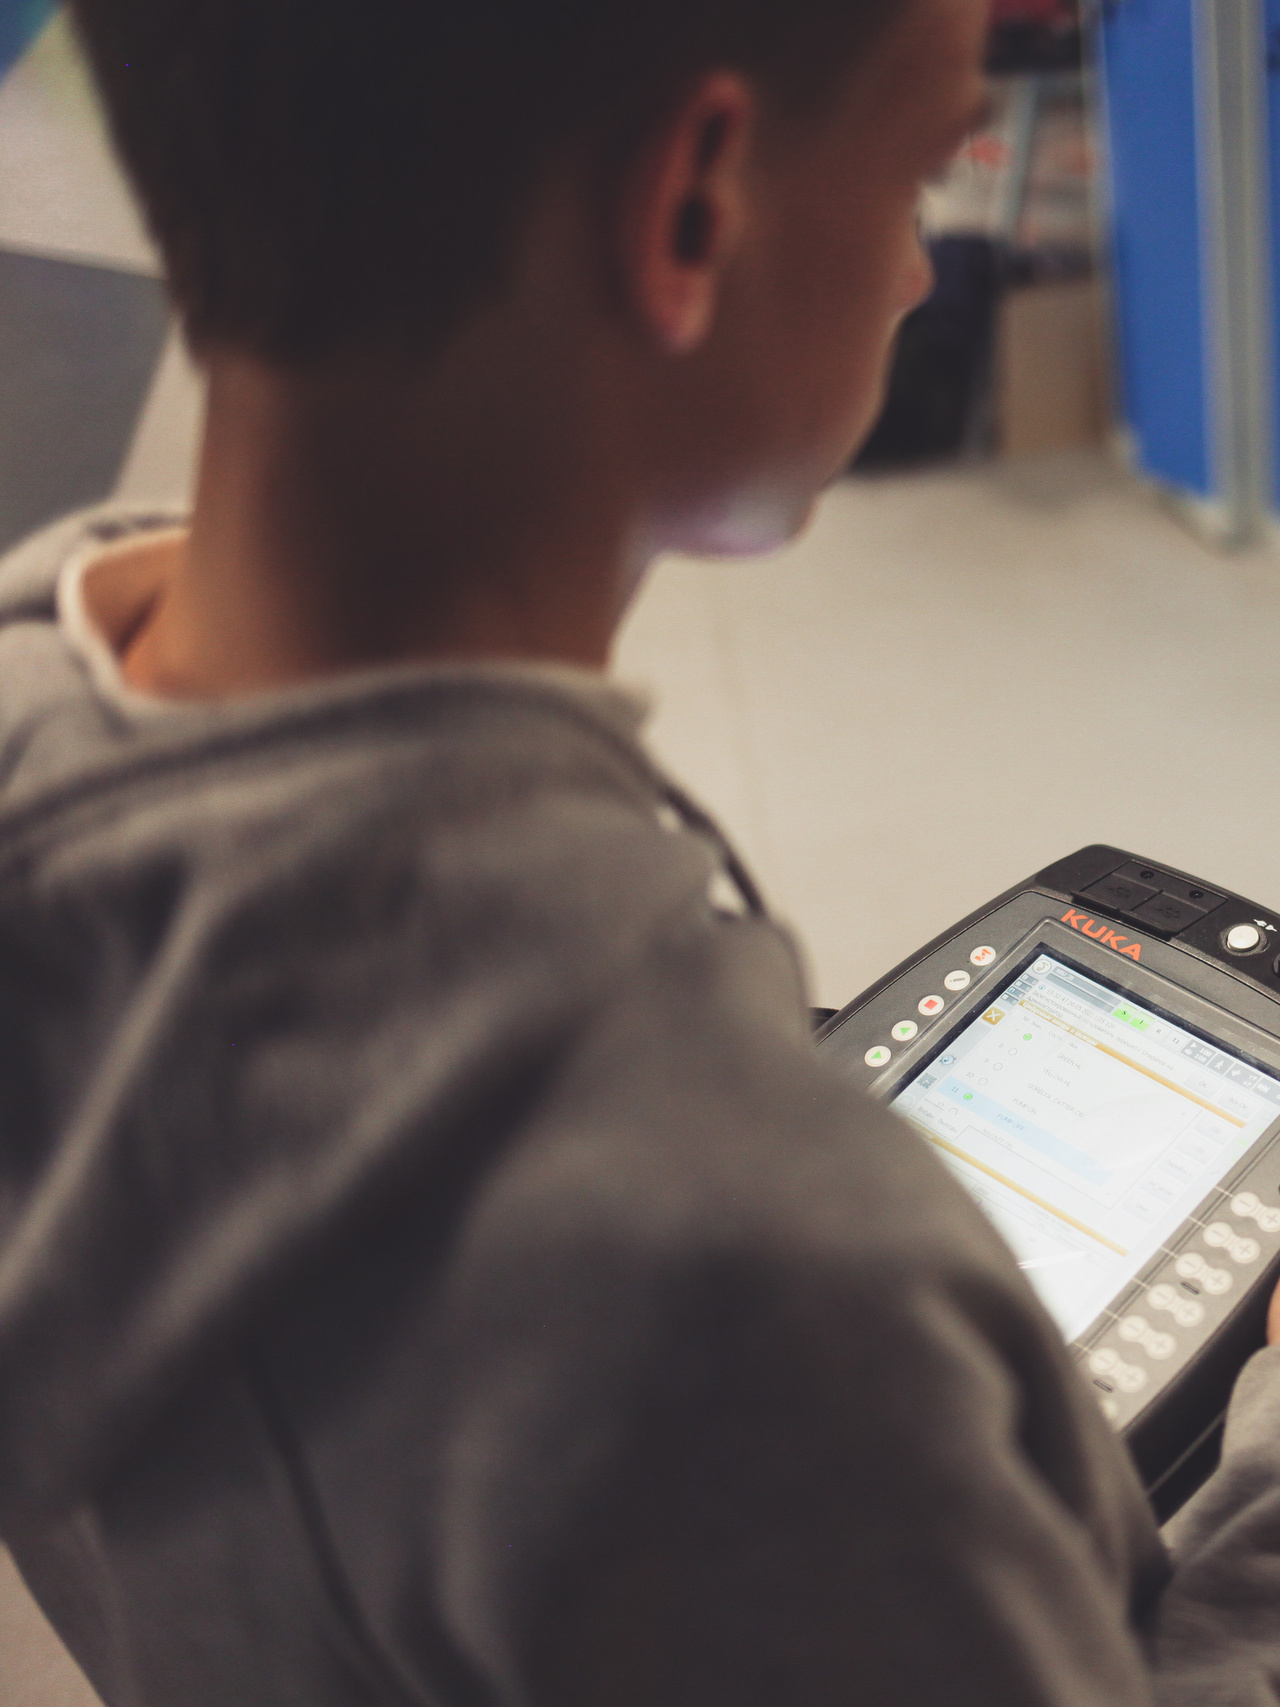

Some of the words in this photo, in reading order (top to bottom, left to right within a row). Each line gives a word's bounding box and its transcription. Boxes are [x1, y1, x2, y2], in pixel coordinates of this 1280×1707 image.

[1060, 909, 1142, 961] KUKA
[1055, 1052, 1076, 1066] GREEN
[1192, 1052, 1208, 1063] 100
[1198, 1047, 1213, 1057] 100
[1040, 1067, 1065, 1083] YELLOW
[965, 1070, 975, 1078] 10
[1010, 1097, 1030, 1110] PUMP
[1026, 1105, 1039, 1115] ON
[949, 1085, 960, 1093] 11
[995, 1112, 1014, 1125] PUMP
[1011, 1121, 1026, 1132] OFF
[1072, 1109, 1086, 1119] ON
